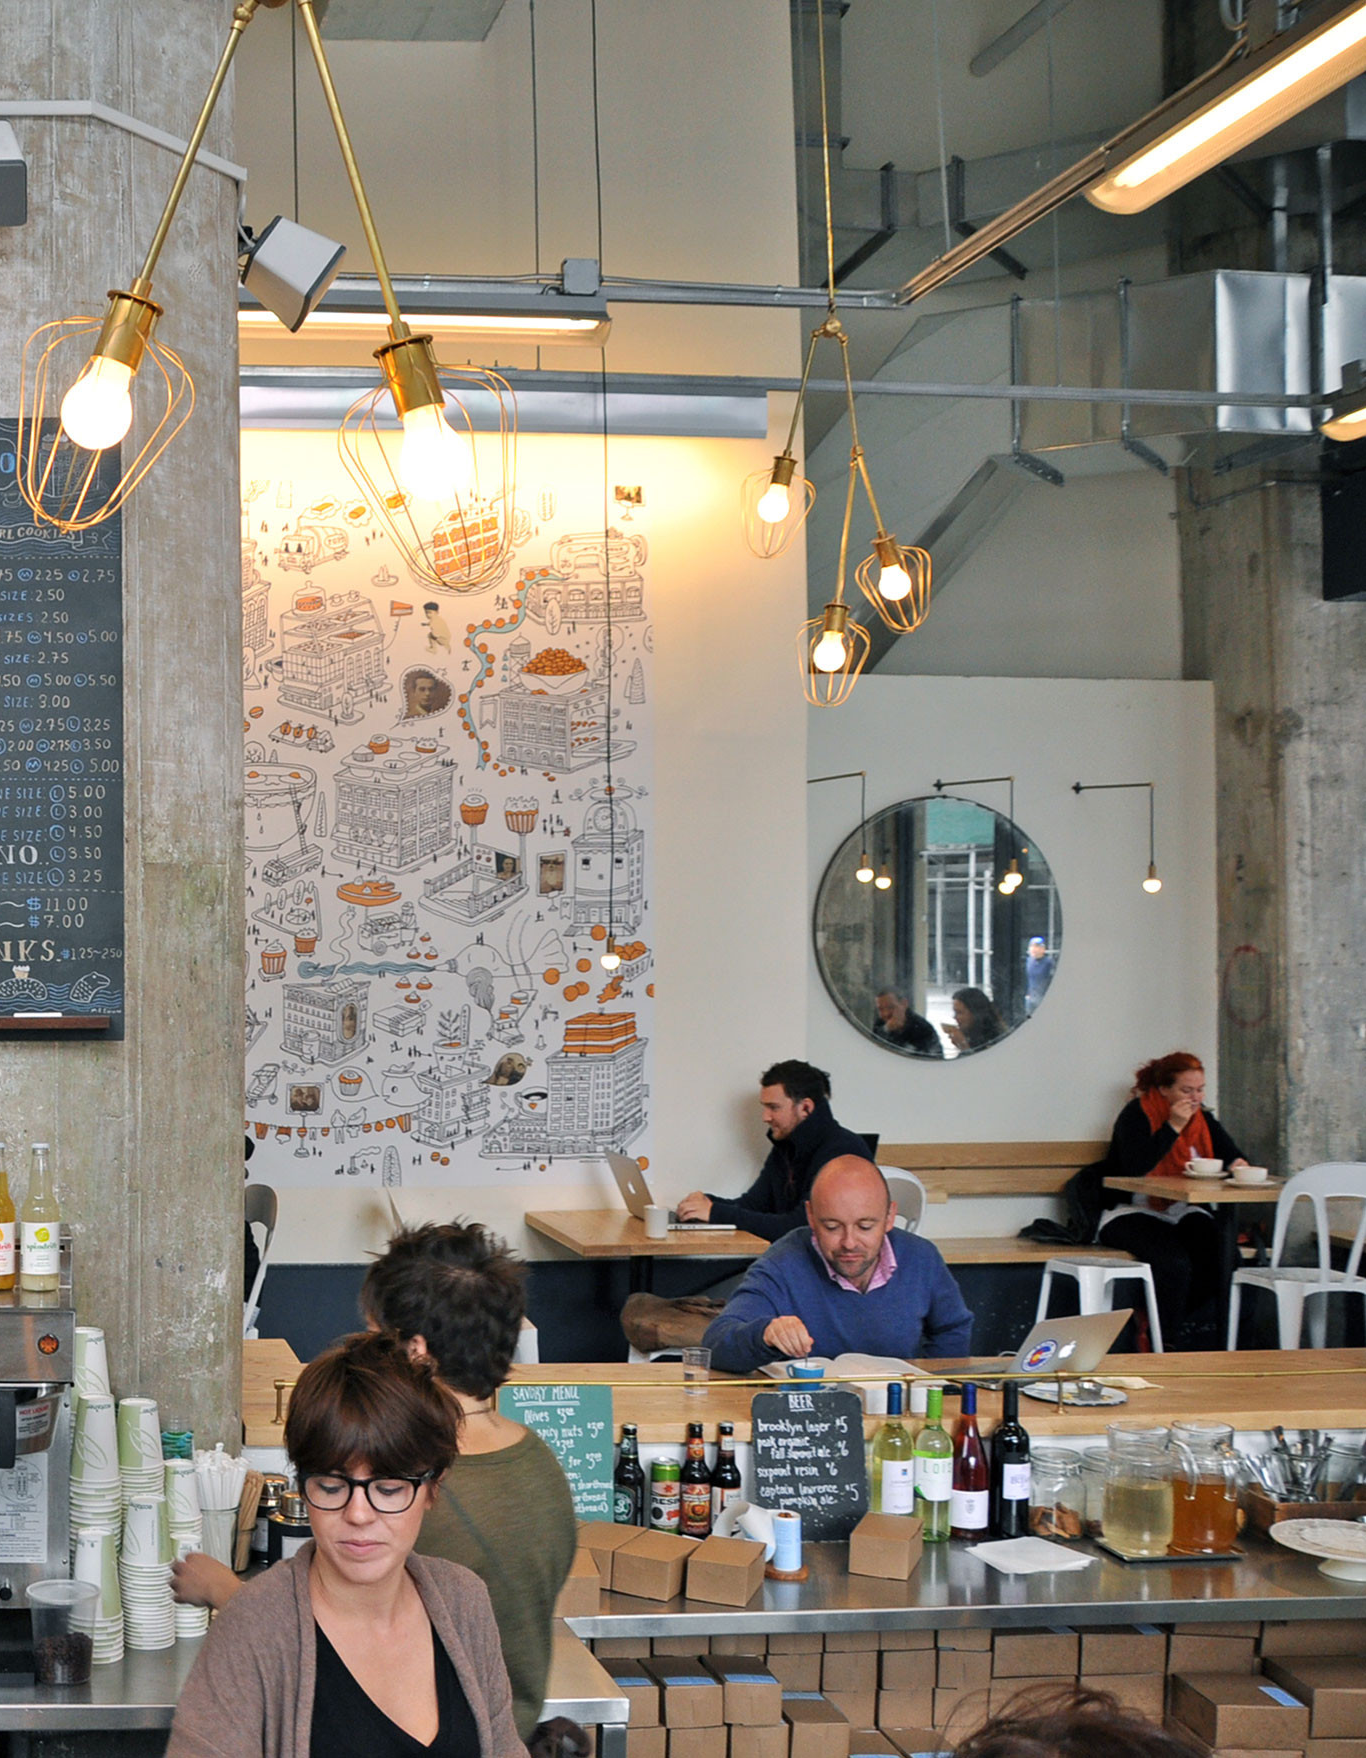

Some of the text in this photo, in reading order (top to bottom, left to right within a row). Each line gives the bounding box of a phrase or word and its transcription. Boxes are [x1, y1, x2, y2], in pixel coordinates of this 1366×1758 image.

[35, 569, 63, 582] 2.25
[82, 569, 116, 583] 2.75
[34, 588, 65, 603] 2.50
[40, 612, 69, 624] 2.50
[44, 631, 74, 645] 4.50
[88, 630, 118, 643] 5.00
[37, 652, 69, 665] 2.75
[44, 673, 72, 686] 5.00
[88, 674, 116, 687] 5.50
[38, 694, 70, 709] 3.00
[35, 718, 66, 732] 2.75
[83, 718, 111, 733] 3.25
[8, 739, 34, 752] 2.00
[49, 740, 71, 751] 2.75
[83, 738, 112, 751] 3.50
[43, 760, 69, 773] 4.25
[89, 758, 120, 773] 5.00
[68, 785, 106, 799] 5.00
[68, 806, 103, 819] 3.00
[69, 825, 103, 839] 4.50
[68, 847, 102, 860] 3.50
[68, 869, 103, 883] 3.25
[27, 896, 89, 911] $11.00
[28, 914, 85, 928] $7.00
[513, 1386, 580, 1402] SAVORY MENU
[788, 1394, 814, 1409] BEER
[757, 1418, 803, 1436] brooklyn
[805, 1419, 831, 1436] lager
[794, 1465, 820, 1476] resin
[760, 1485, 795, 1499] captain
[798, 1483, 838, 1495] lawrence
